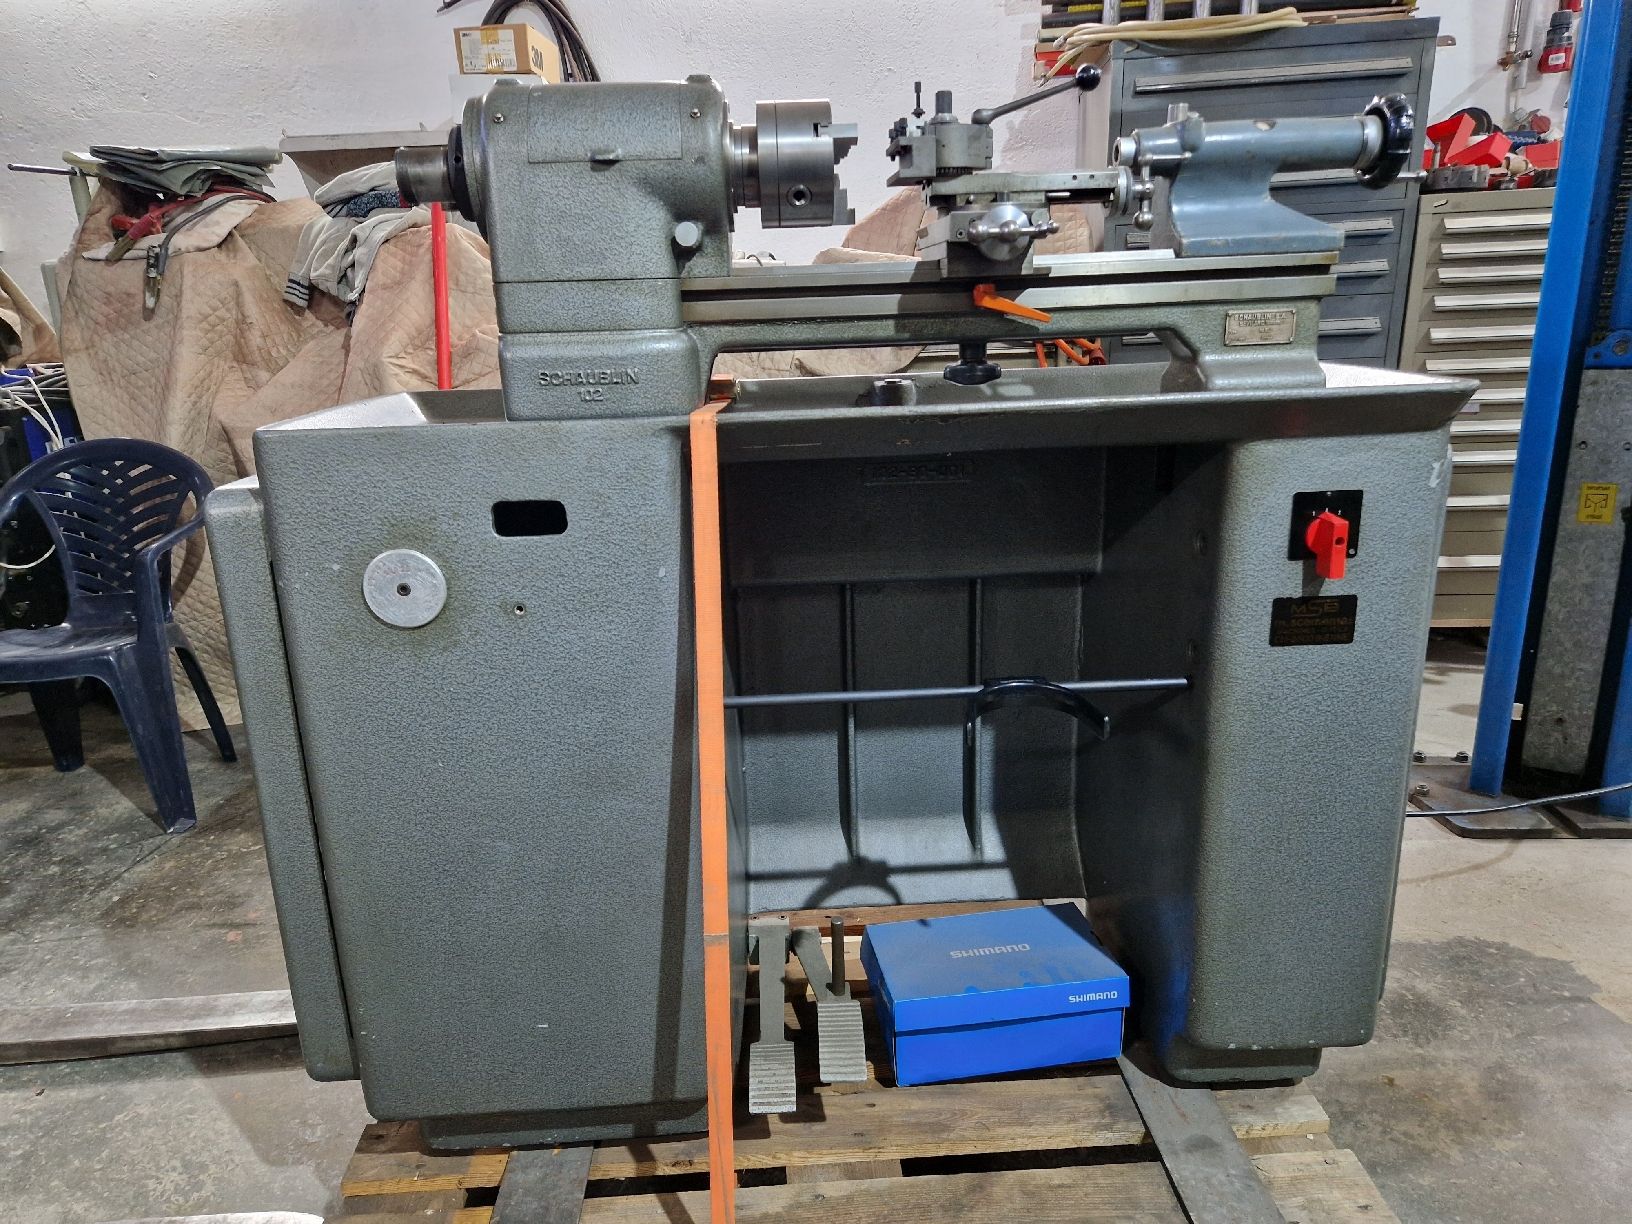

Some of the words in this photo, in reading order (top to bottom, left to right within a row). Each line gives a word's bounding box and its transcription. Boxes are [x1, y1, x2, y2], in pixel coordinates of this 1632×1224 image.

[531, 45, 544, 72] 3M
[539, 368, 640, 387] SCHAUBLIN
[577, 388, 604, 402] 102
[950, 943, 1031, 959] SHIMANO
[1068, 991, 1118, 1003] SHIMANO
